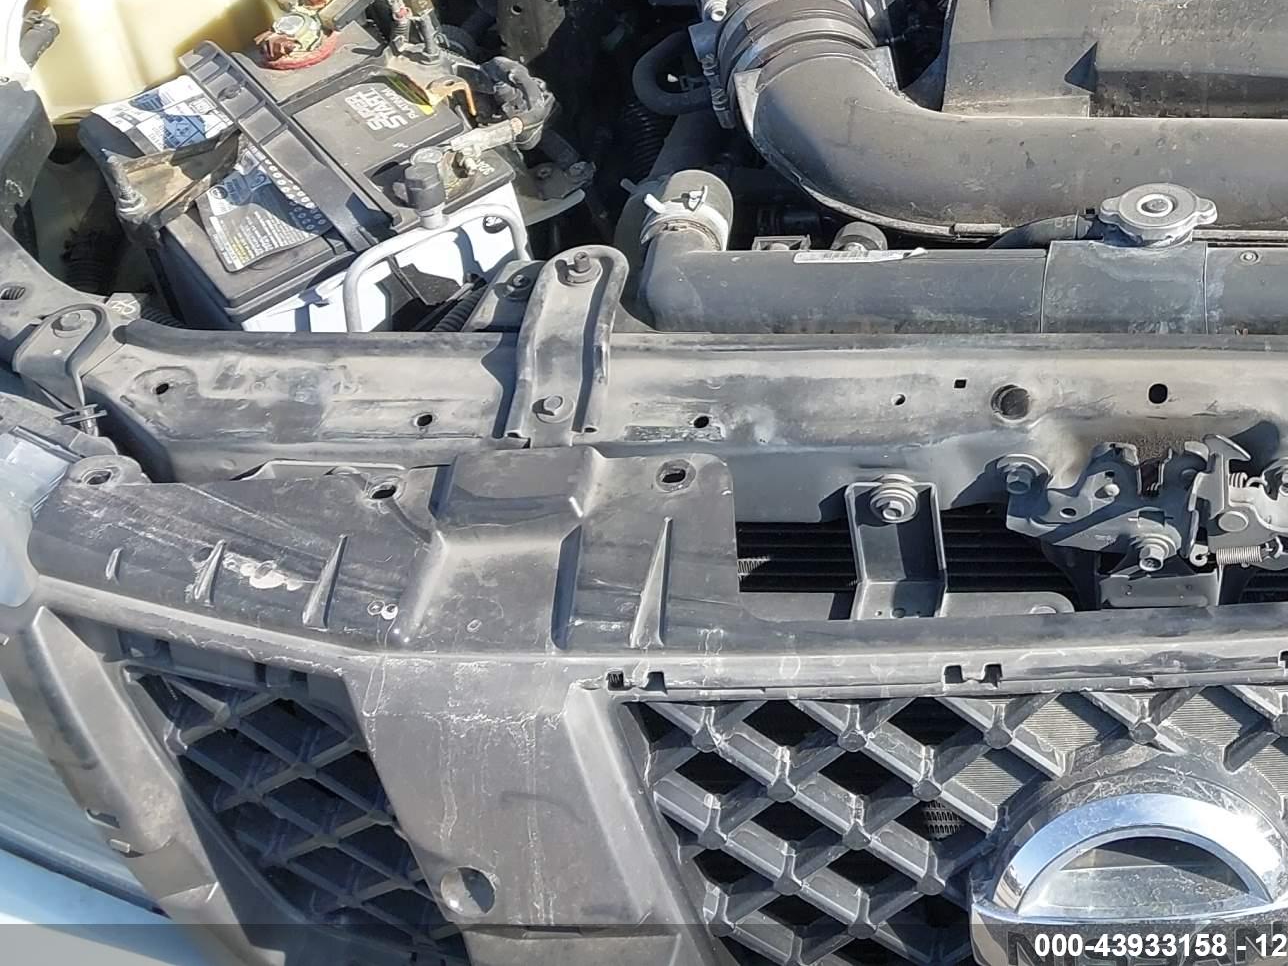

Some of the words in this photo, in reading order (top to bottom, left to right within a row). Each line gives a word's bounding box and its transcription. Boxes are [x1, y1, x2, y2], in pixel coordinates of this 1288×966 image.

[344, 92, 383, 131] SUPER
[364, 87, 408, 130] START
[382, 88, 420, 121] PLATINUM
